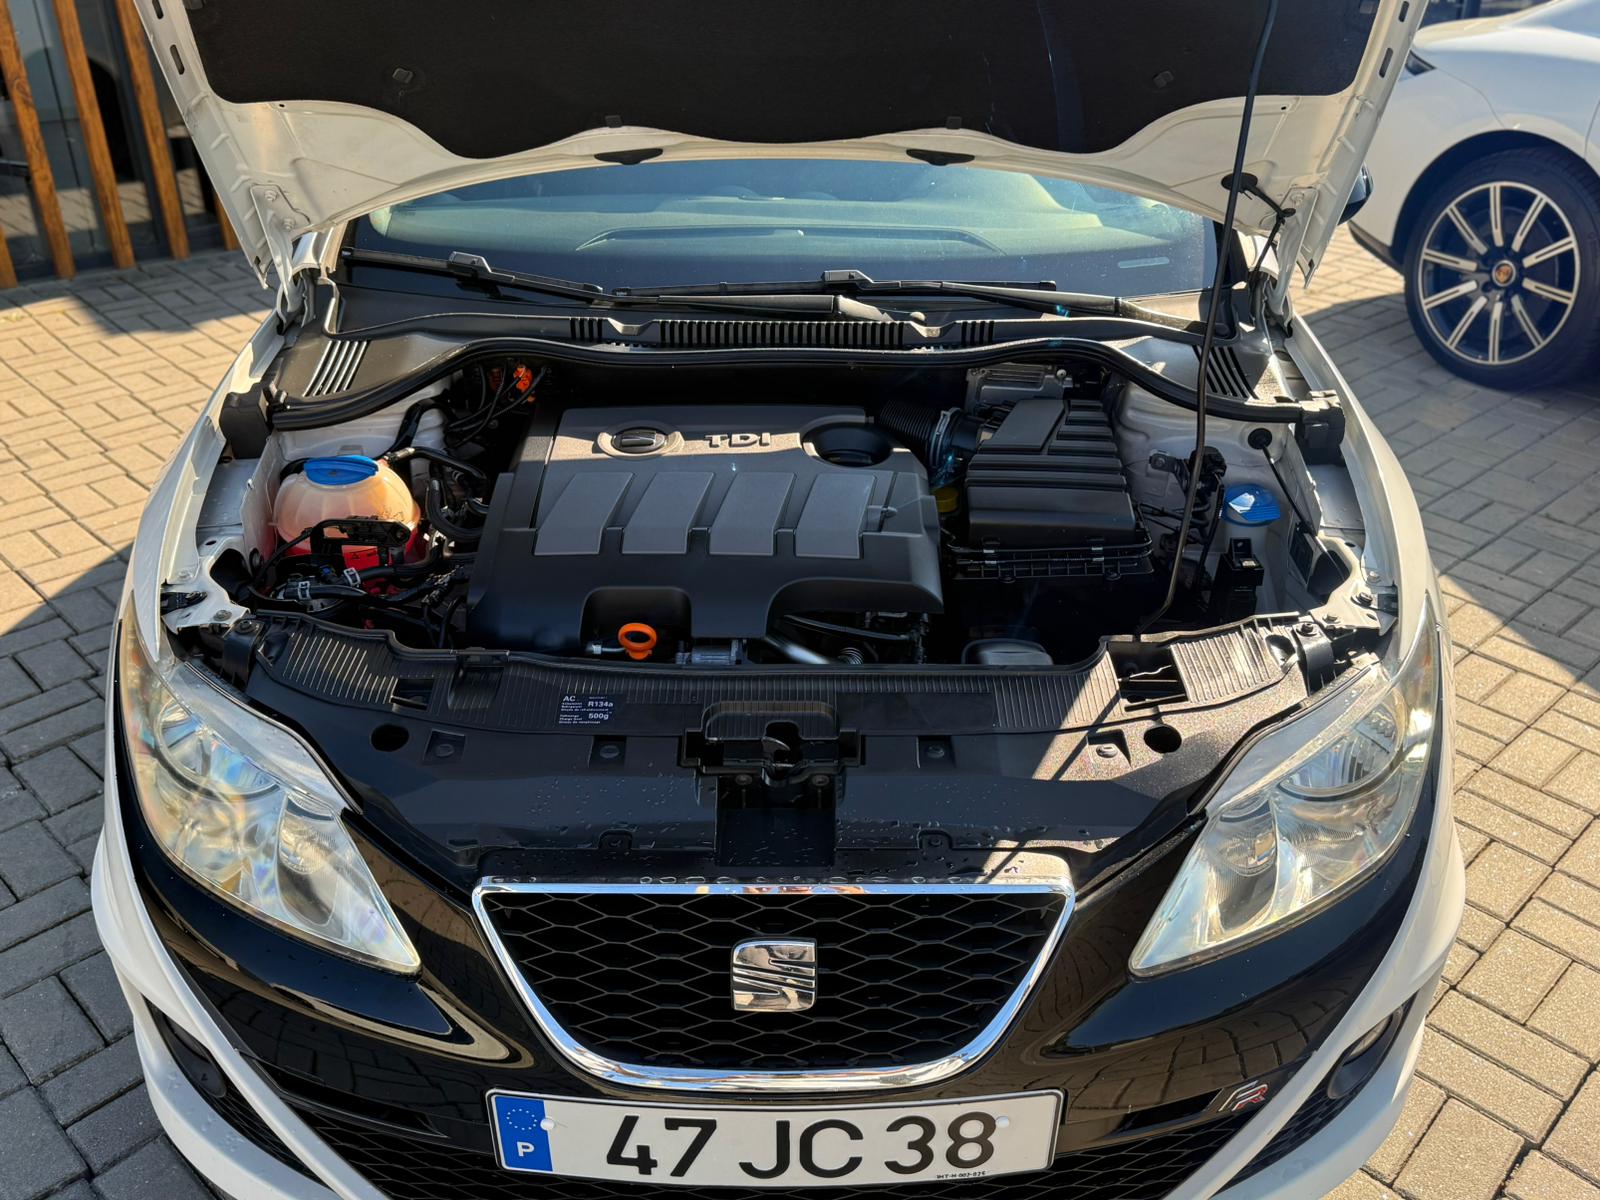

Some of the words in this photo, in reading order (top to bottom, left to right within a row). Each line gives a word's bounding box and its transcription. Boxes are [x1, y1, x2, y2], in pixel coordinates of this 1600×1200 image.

[704, 432, 771, 449] TDI
[516, 1141, 535, 1157] P
[606, 1115, 717, 1178] 47
[738, 1119, 864, 1180] JC
[884, 1111, 997, 1175] 38
